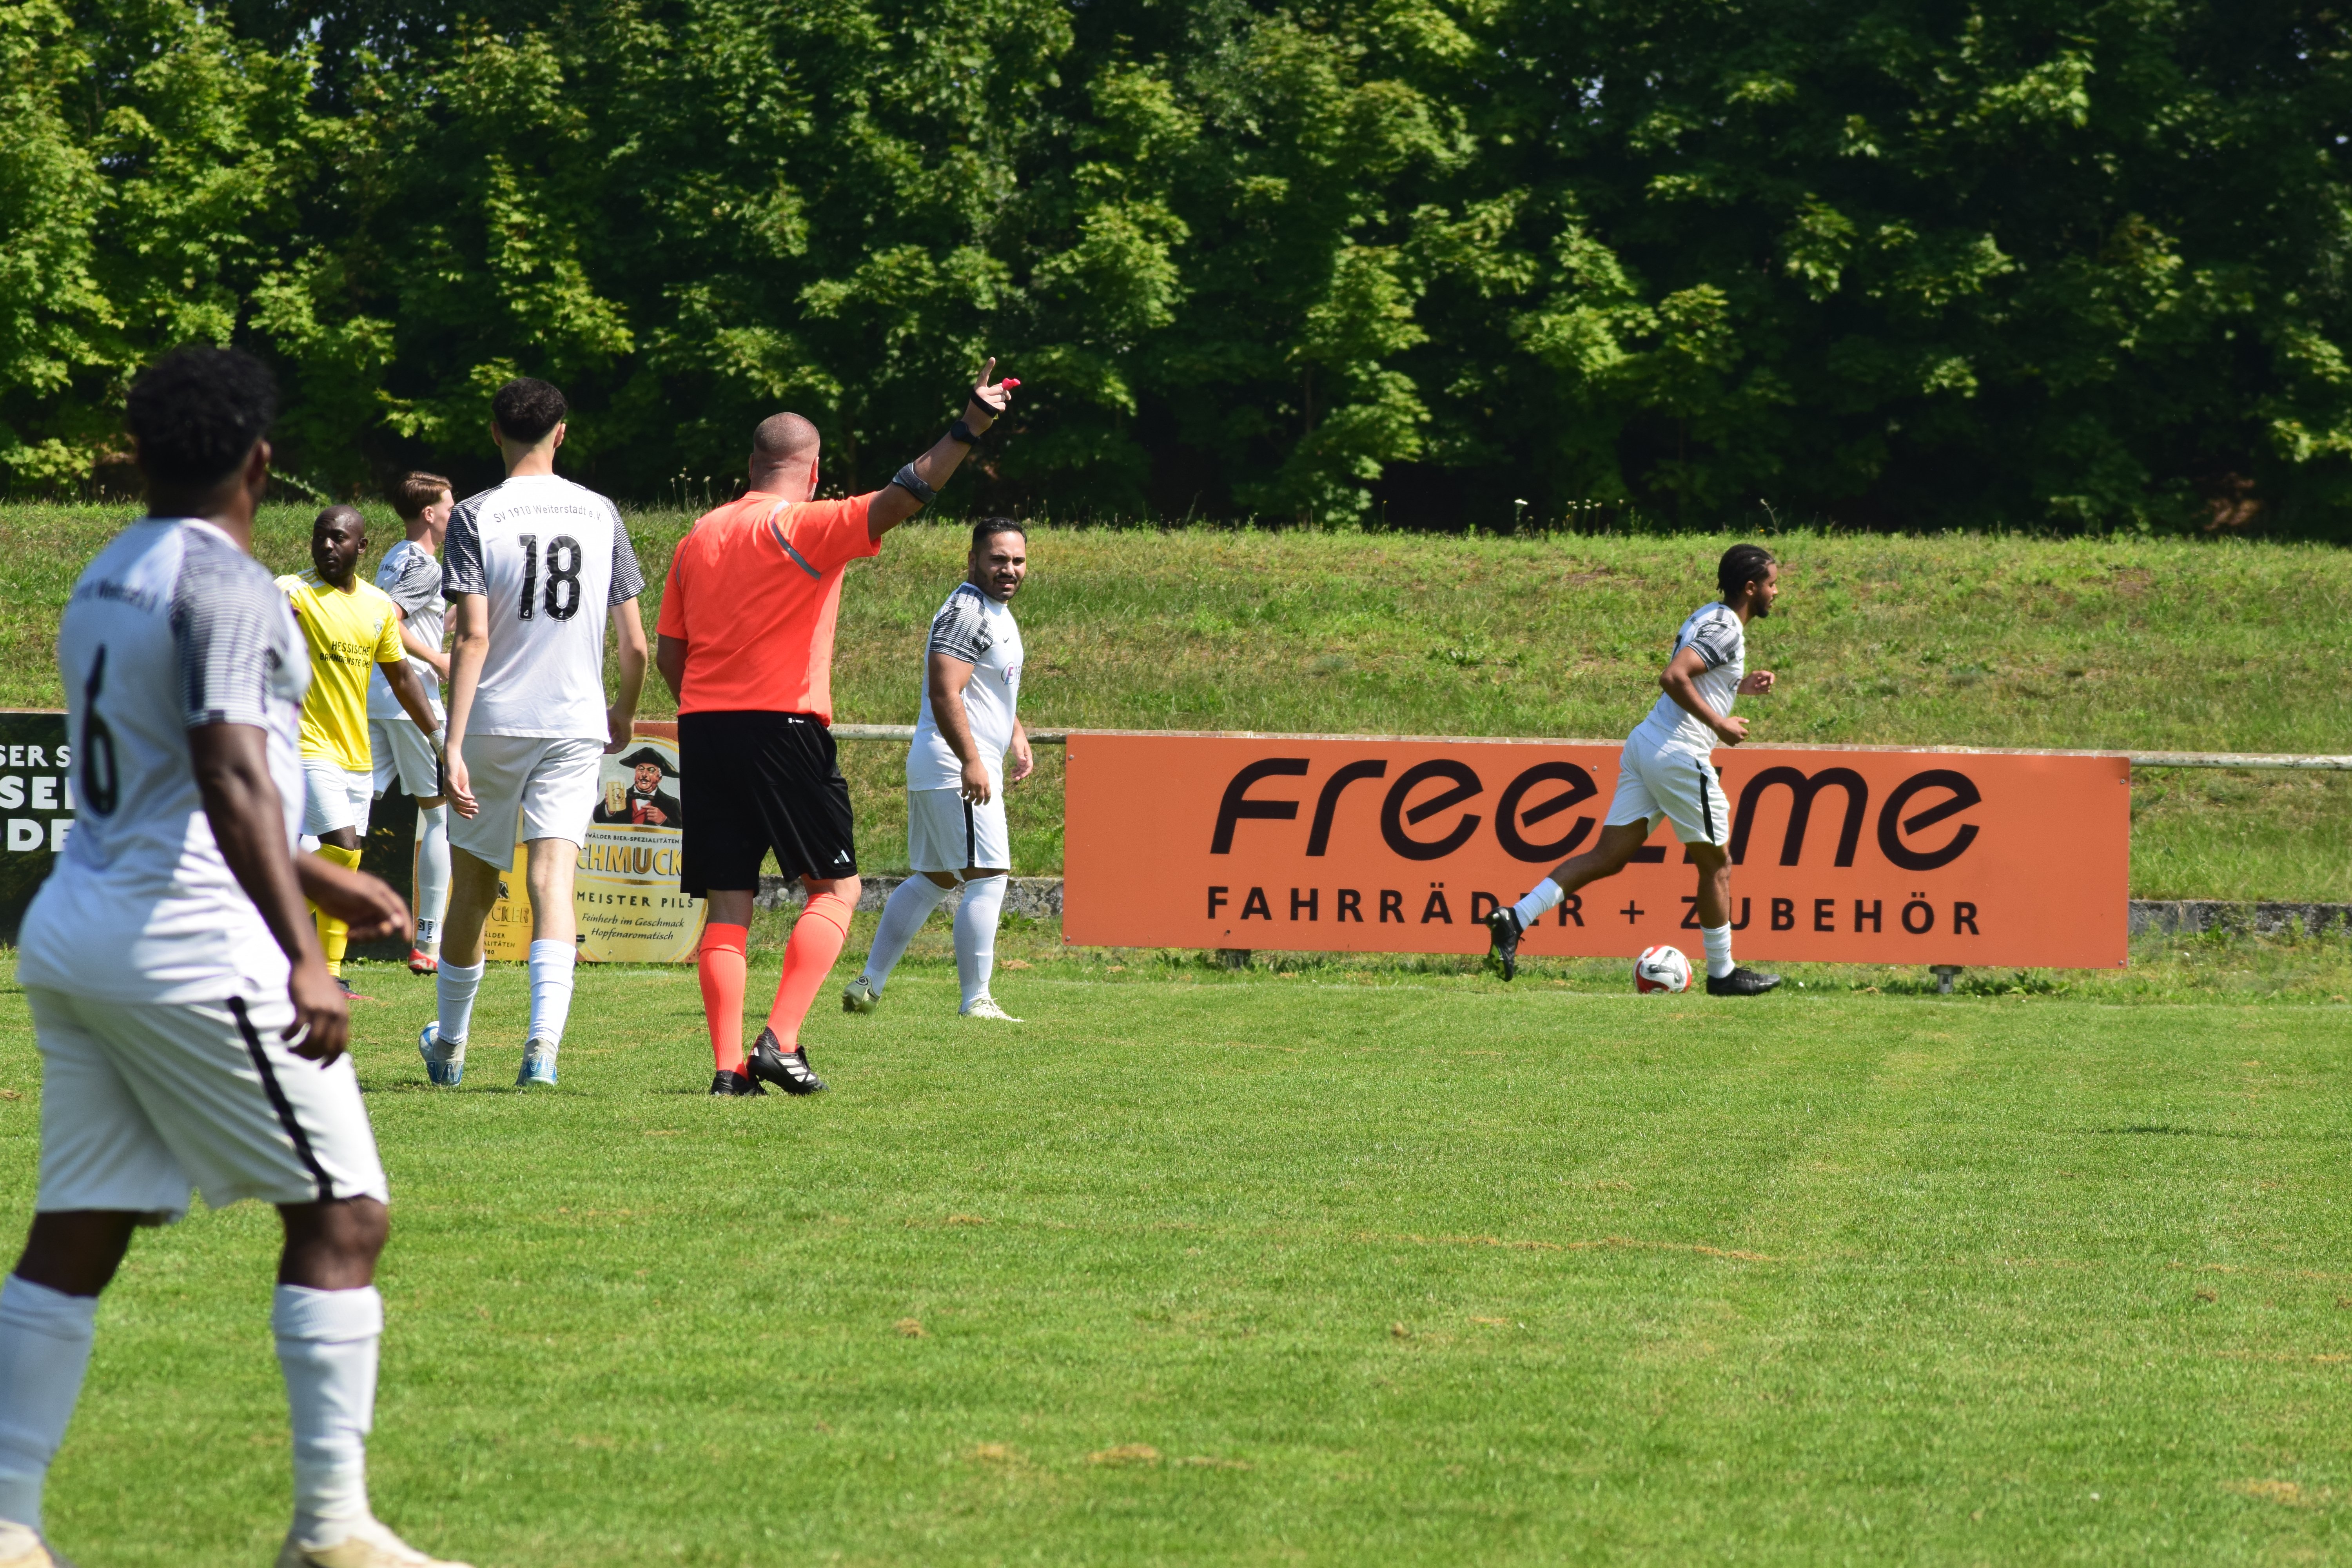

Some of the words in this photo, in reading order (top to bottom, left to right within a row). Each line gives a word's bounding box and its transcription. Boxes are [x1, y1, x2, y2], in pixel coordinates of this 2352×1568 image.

[494, 511, 506, 523] SV
[508, 506, 531, 517] 1910
[533, 505, 586, 515] Weiterstadt
[589, 511, 601, 522] e.V.
[517, 533, 583, 622] 18
[331, 641, 370, 656] HESSISCHE
[1209, 757, 1982, 871] Freeme
[0, 818, 75, 851] DE
[577, 891, 651, 907] MEISTER
[661, 897, 693, 908] PILS
[1208, 882, 1585, 927] FAHRRÄDR
[1680, 891, 1980, 936] ZUBEHÖR
[582, 913, 618, 924] Feinherb
[635, 918, 684, 927] Geschmack
[592, 927, 673, 940] Hopfenaromatisch
